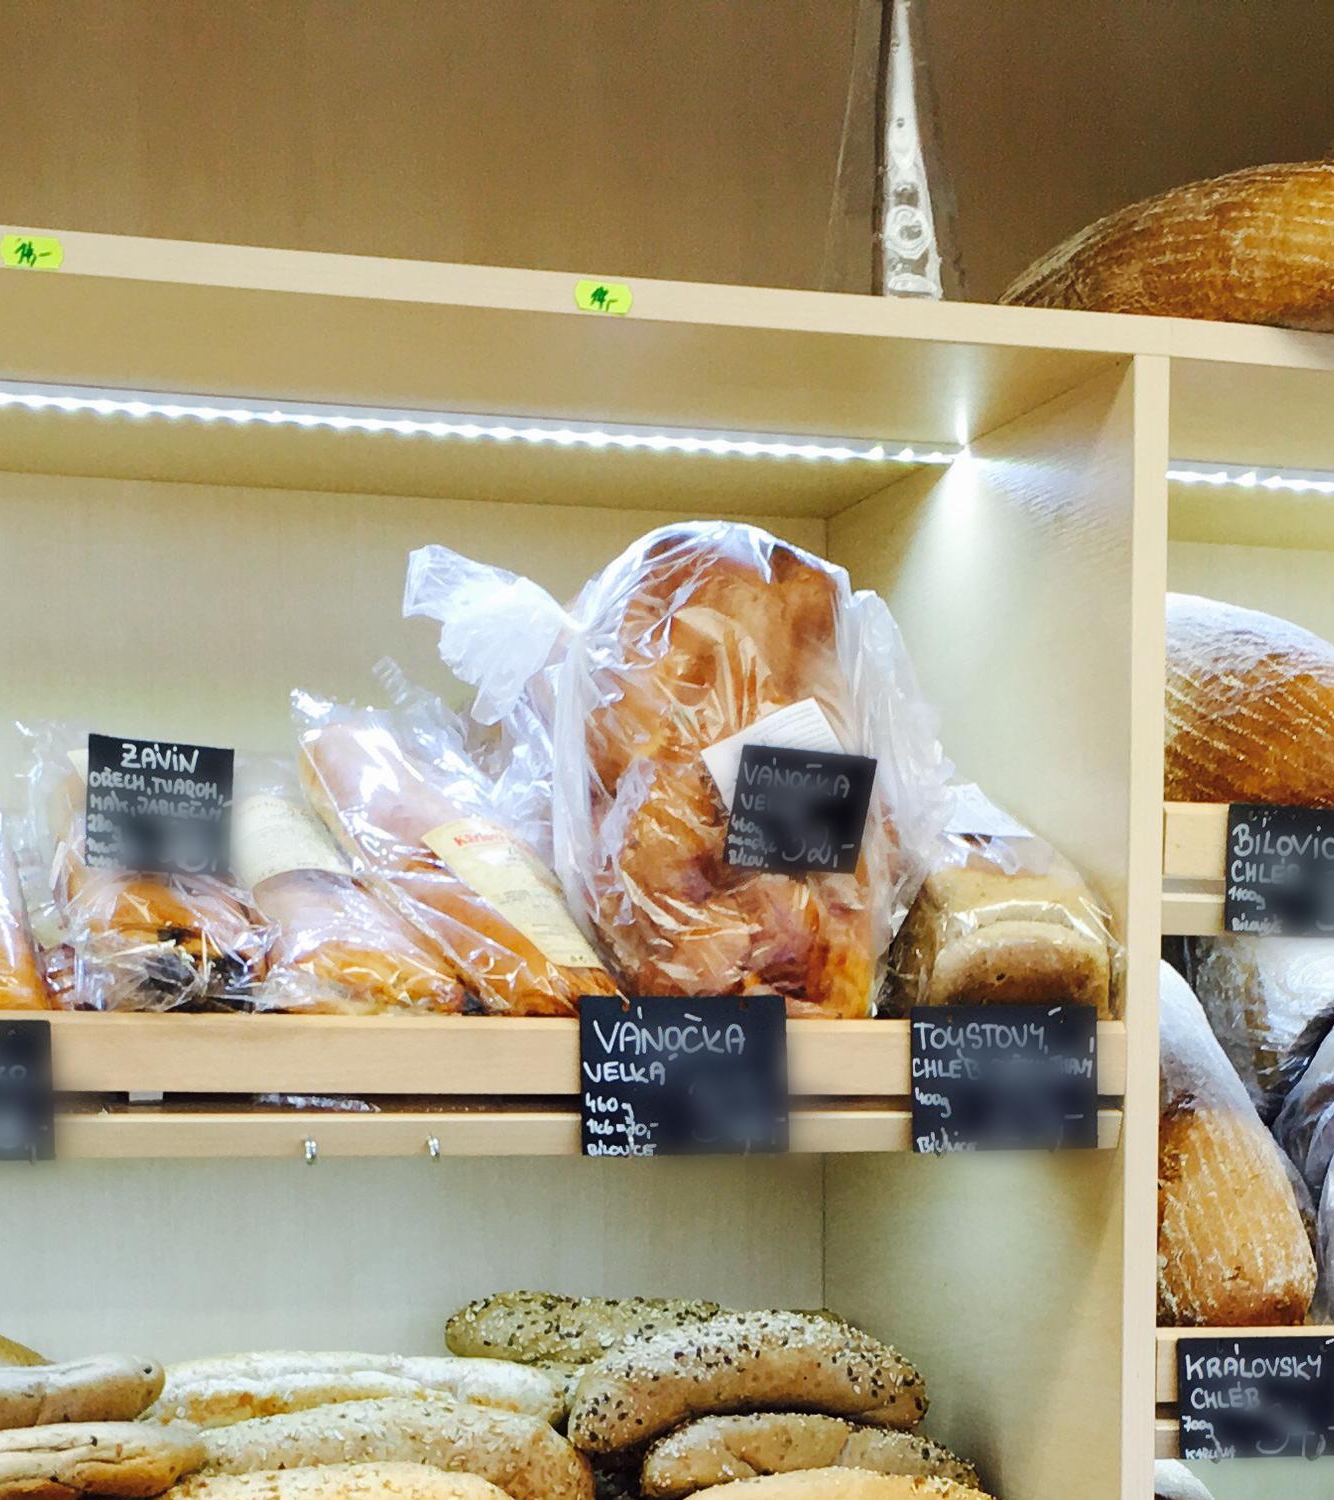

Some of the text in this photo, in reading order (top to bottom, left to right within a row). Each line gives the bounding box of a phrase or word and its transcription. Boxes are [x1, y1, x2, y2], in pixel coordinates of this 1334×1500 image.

[120, 743, 200, 775] ZÁVIN
[593, 1006, 747, 1056] VÁNOČKA
[582, 1053, 679, 1086] VELKÁ
[1190, 1381, 1262, 1411] CHLÉB
